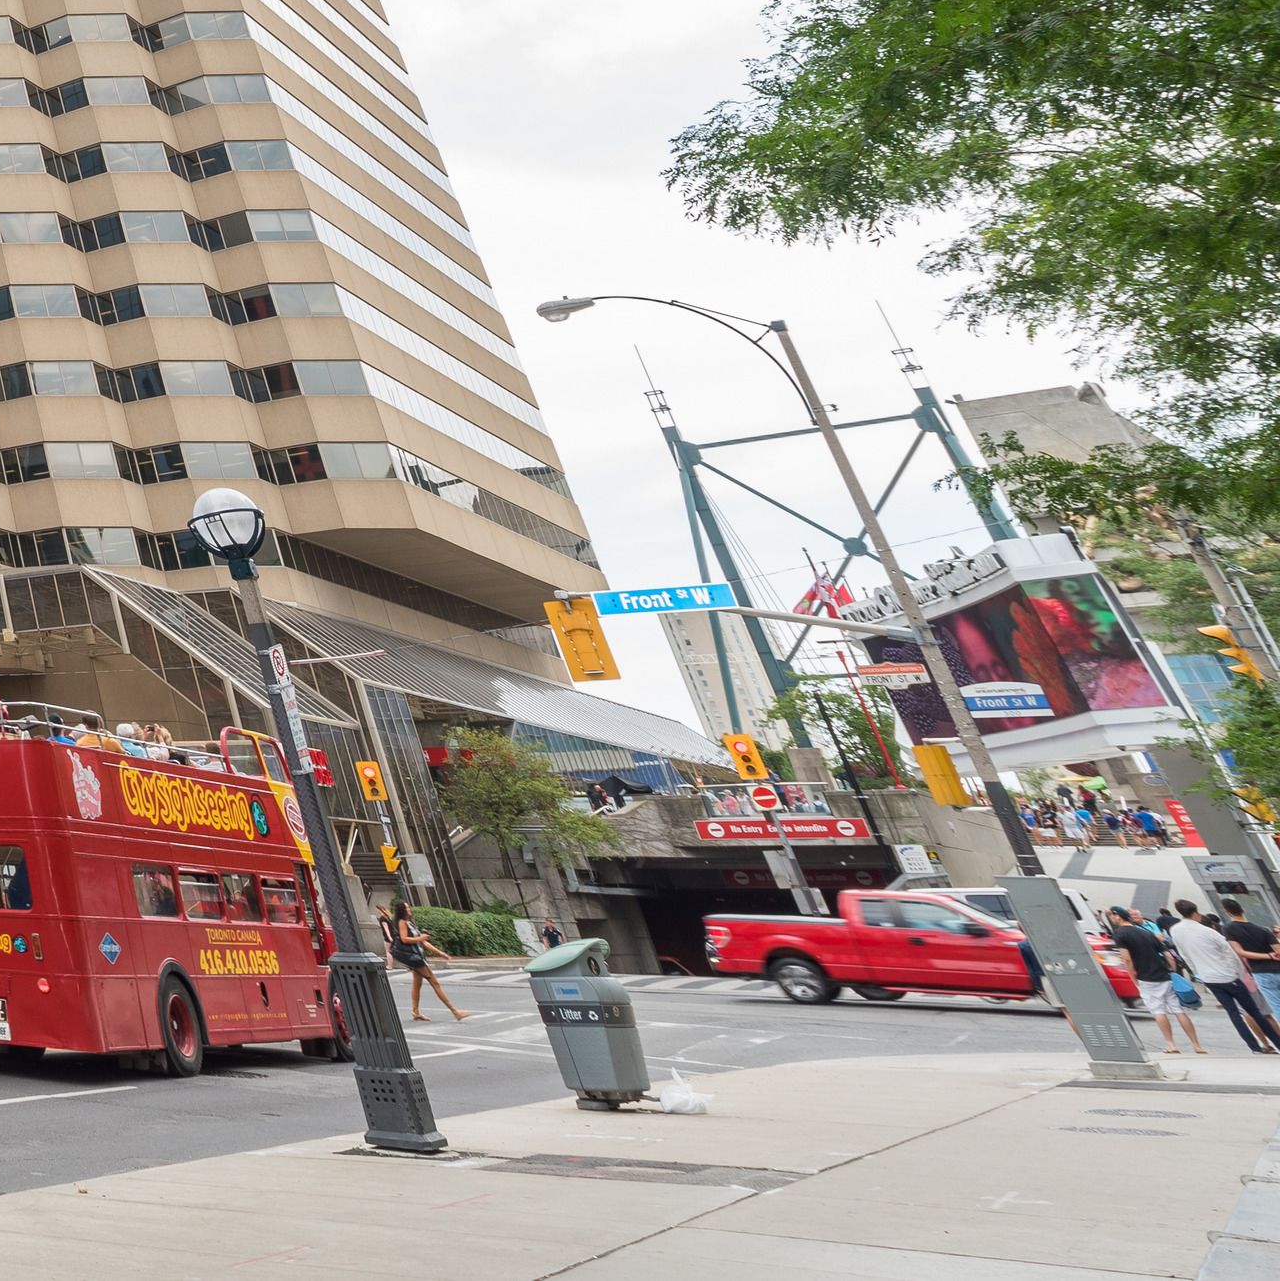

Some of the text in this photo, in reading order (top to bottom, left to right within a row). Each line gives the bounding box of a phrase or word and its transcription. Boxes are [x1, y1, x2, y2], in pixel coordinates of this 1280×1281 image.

[618, 587, 711, 610] Front St W
[865, 675, 894, 685] FRONT
[974, 695, 1038, 708] Front St W
[729, 825, 742, 833] No
[742, 825, 763, 834] Entry
[794, 823, 829, 833] interdite
[205, 928, 263, 945] TORONTO CANADA
[200, 949, 280, 975] 416.410.0536
[559, 1007, 582, 1022] Litter
